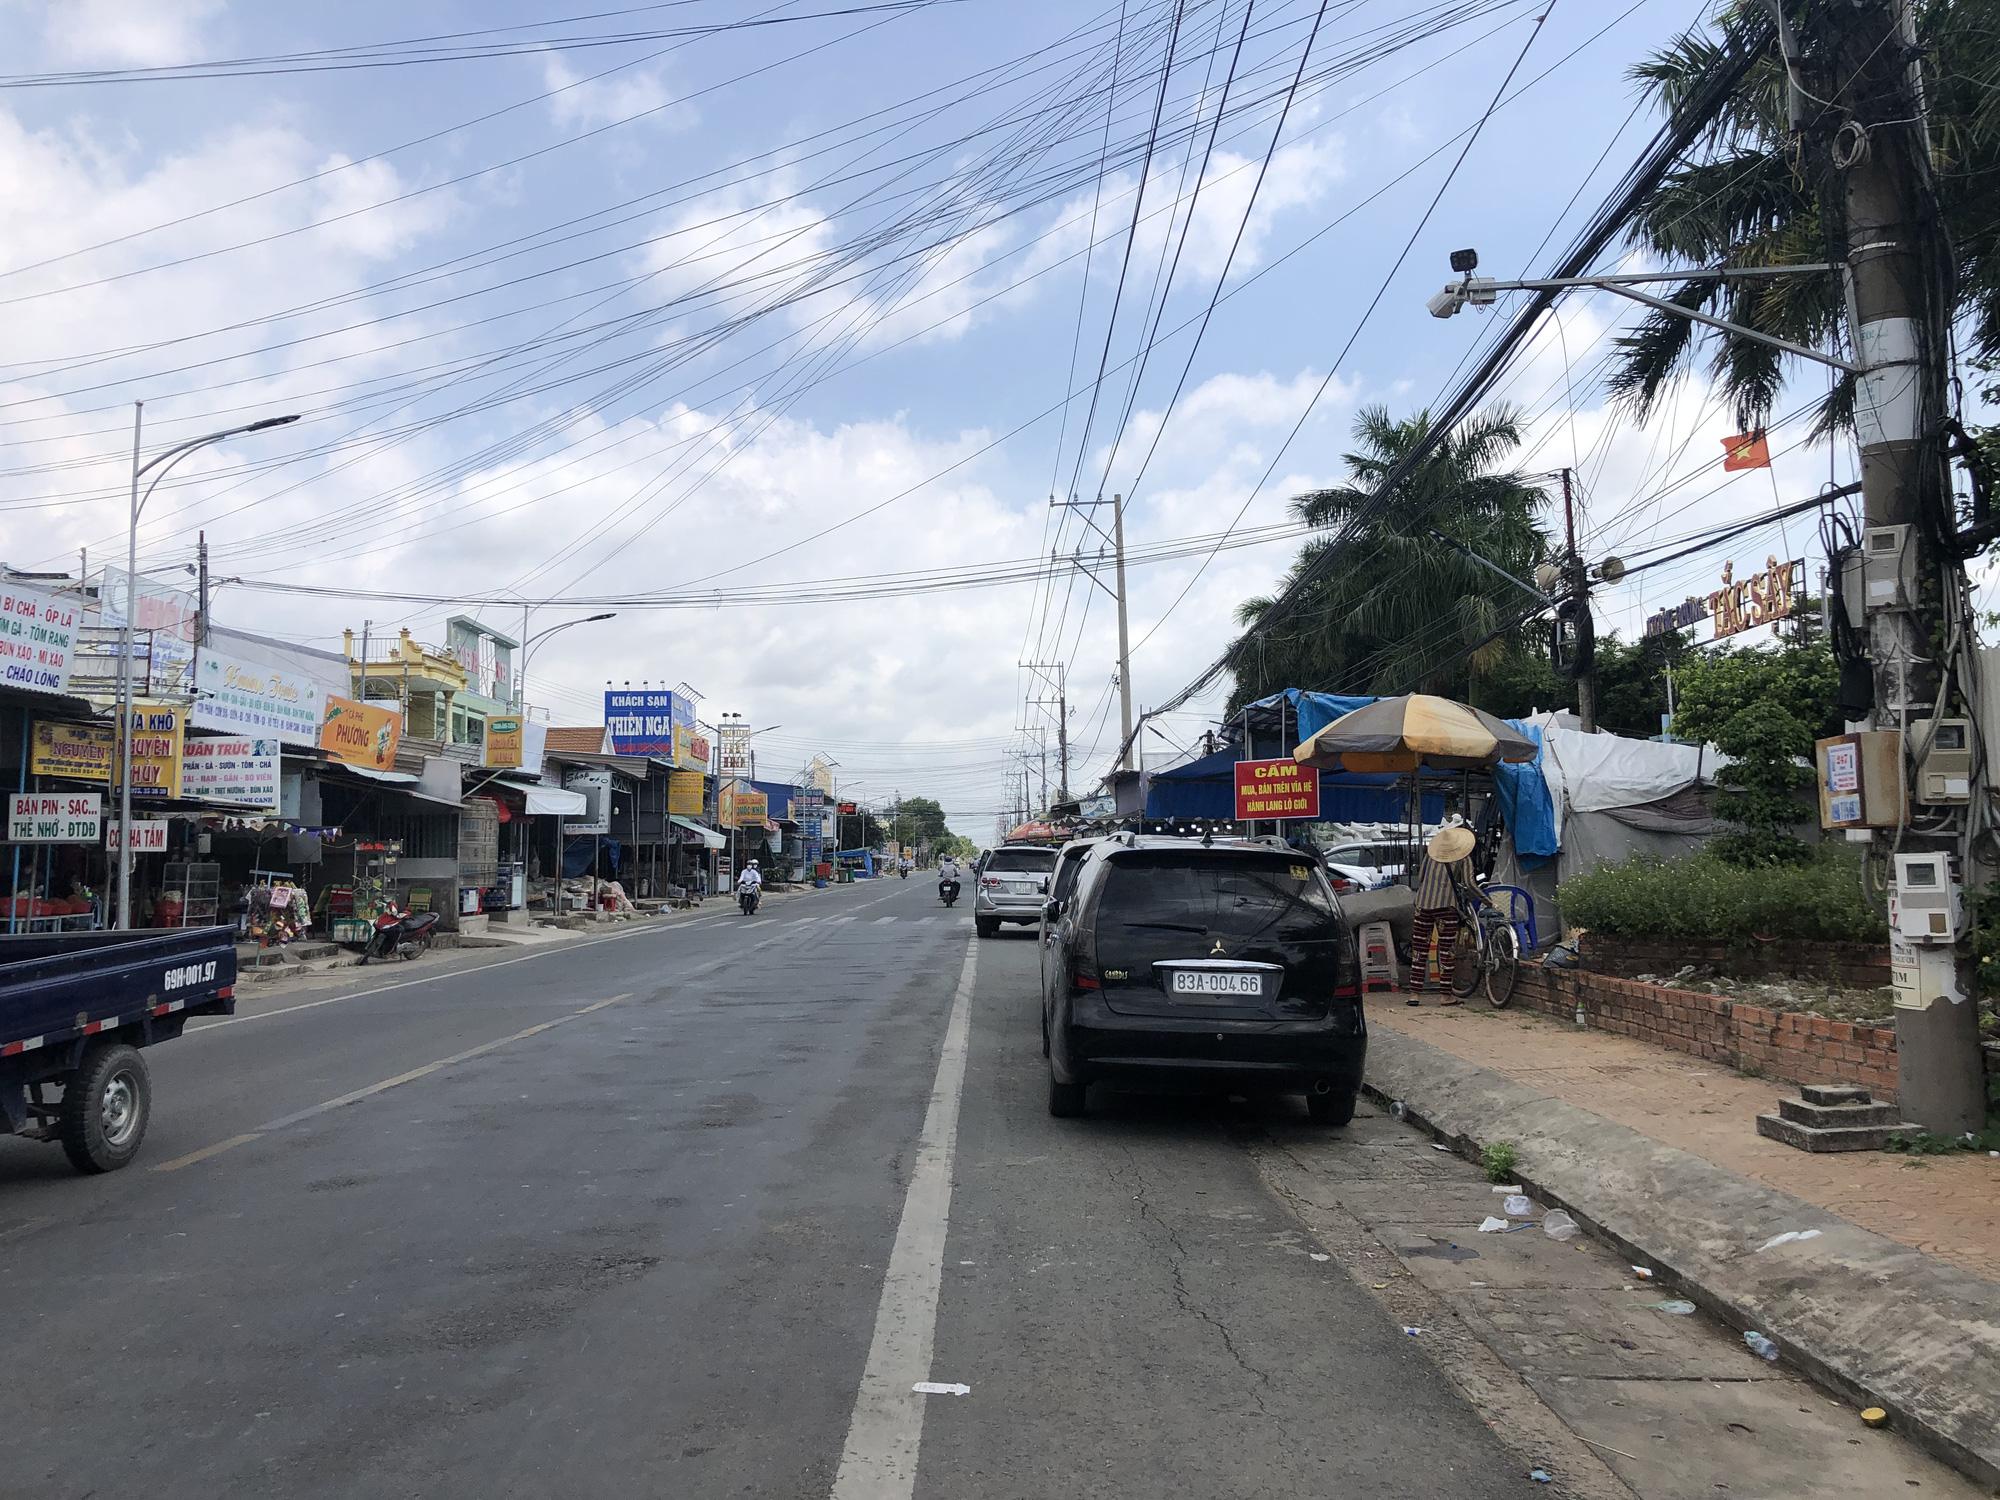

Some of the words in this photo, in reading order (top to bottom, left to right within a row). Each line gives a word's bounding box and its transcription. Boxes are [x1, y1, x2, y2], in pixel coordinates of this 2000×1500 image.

[4, 595, 15, 612] BÌ
[16, 599, 36, 618] CHẢ
[45, 604, 59, 623] ỐP
[60, 612, 72, 628] LA
[11, 619, 22, 636] GÀ
[30, 624, 47, 643] TÔM
[48, 631, 69, 648] RANG
[16, 642, 32, 661] XÀO
[48, 650, 64, 668] XÀO
[6, 665, 33, 682] CHÁO
[34, 668, 60, 688] LÒNG
[612, 694, 644, 706] KHÁCH
[647, 696, 667, 708] SẠN
[149, 709, 175, 730] KHÔ
[608, 712, 643, 736] THIÊN
[646, 716, 670, 736] NGA
[336, 724, 370, 747] PHƯƠNG
[217, 740, 250, 756] TRÚC
[132, 760, 160, 784] HỦY
[205, 761, 213, 770] GÀ
[241, 760, 254, 769] TÔM
[260, 759, 271, 768] CHẢ
[1254, 763, 1297, 778] CẤM
[567, 772, 589, 782] Shop
[1241, 785, 1257, 796] MUA,
[1258, 782, 1272, 794] BÁN
[1273, 781, 1290, 794] TRÊN
[1304, 780, 1312, 792] HÈ
[16, 797, 38, 815] BÁN
[41, 800, 59, 815] PIN
[68, 799, 98, 817] SẠC...
[1247, 800, 1264, 812] HÀNH
[1266, 801, 1282, 810] LANG
[1284, 798, 1292, 812] LỘ
[1294, 797, 1307, 810] GIỚI
[13, 817, 33, 837] THẺ
[38, 818, 59, 837] NHỚ
[68, 822, 96, 837] ĐTDĐ
[129, 826, 140, 847] HÀ
[144, 822, 163, 847] TẮM
[164, 961, 216, 991] 69H-001.97
[1177, 974, 1258, 992] 83A-004.66
